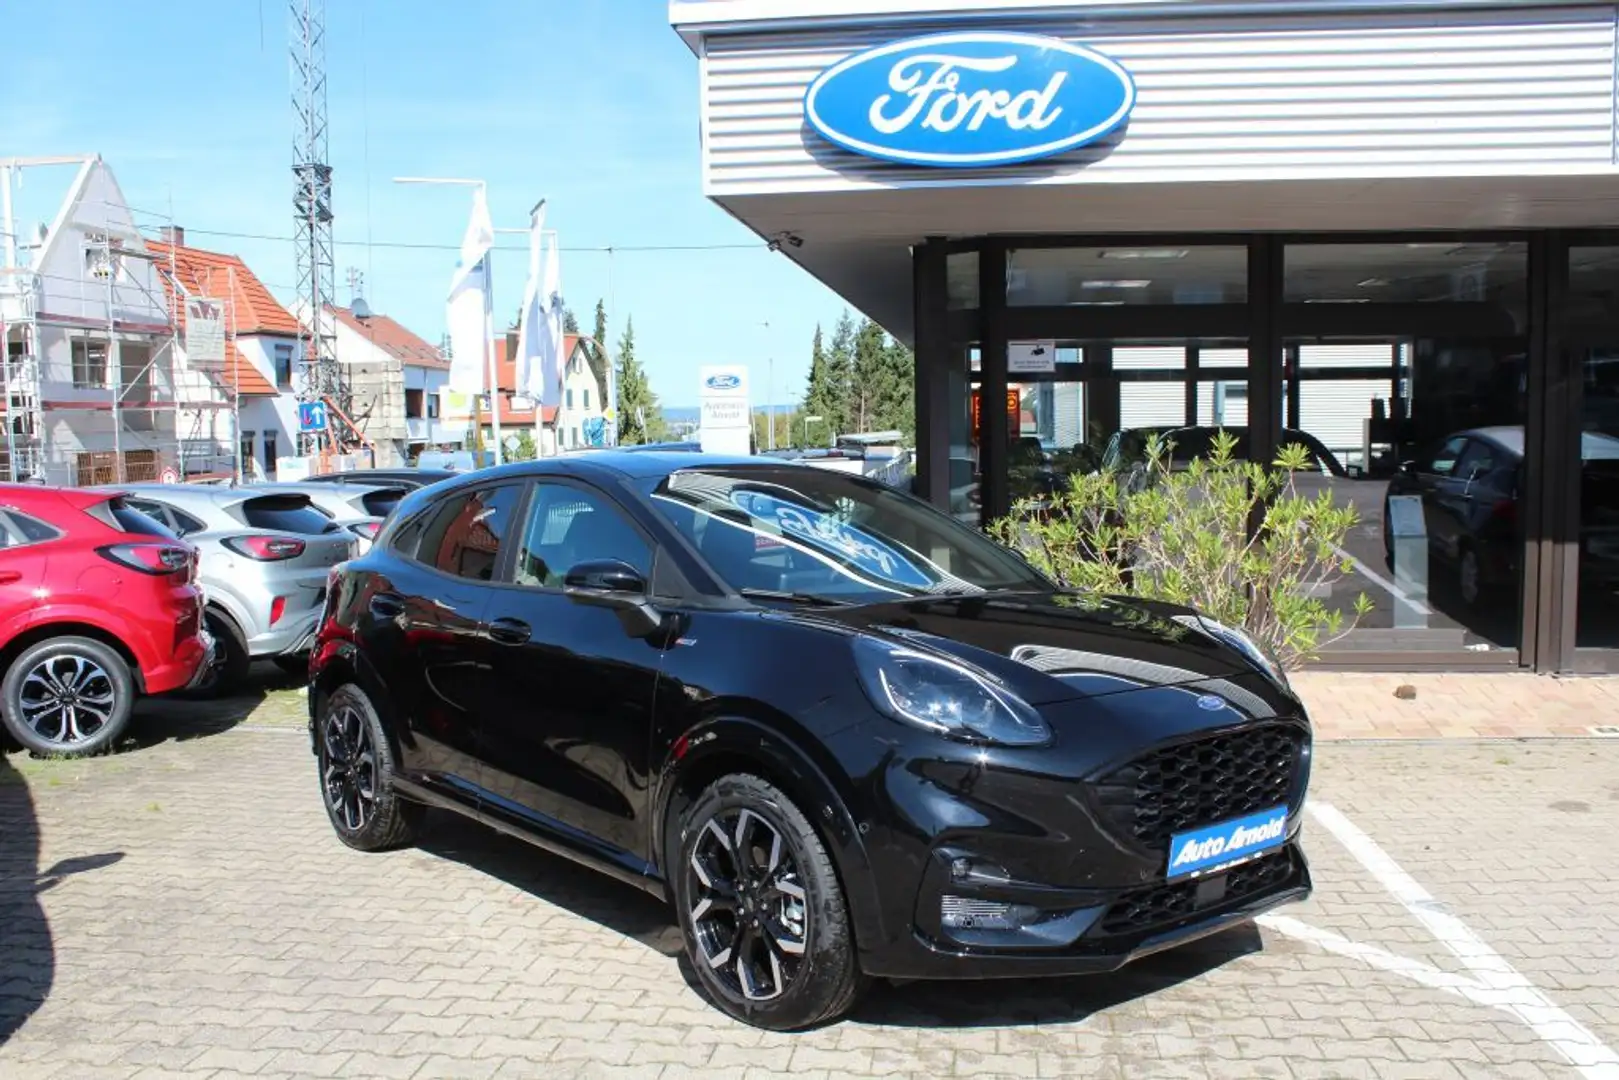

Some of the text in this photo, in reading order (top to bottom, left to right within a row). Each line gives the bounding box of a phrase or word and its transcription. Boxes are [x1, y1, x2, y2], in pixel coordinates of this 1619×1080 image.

[868, 53, 1068, 134] Ford
[1172, 838, 1226, 867] Auto
[1224, 815, 1286, 852] Arnold
